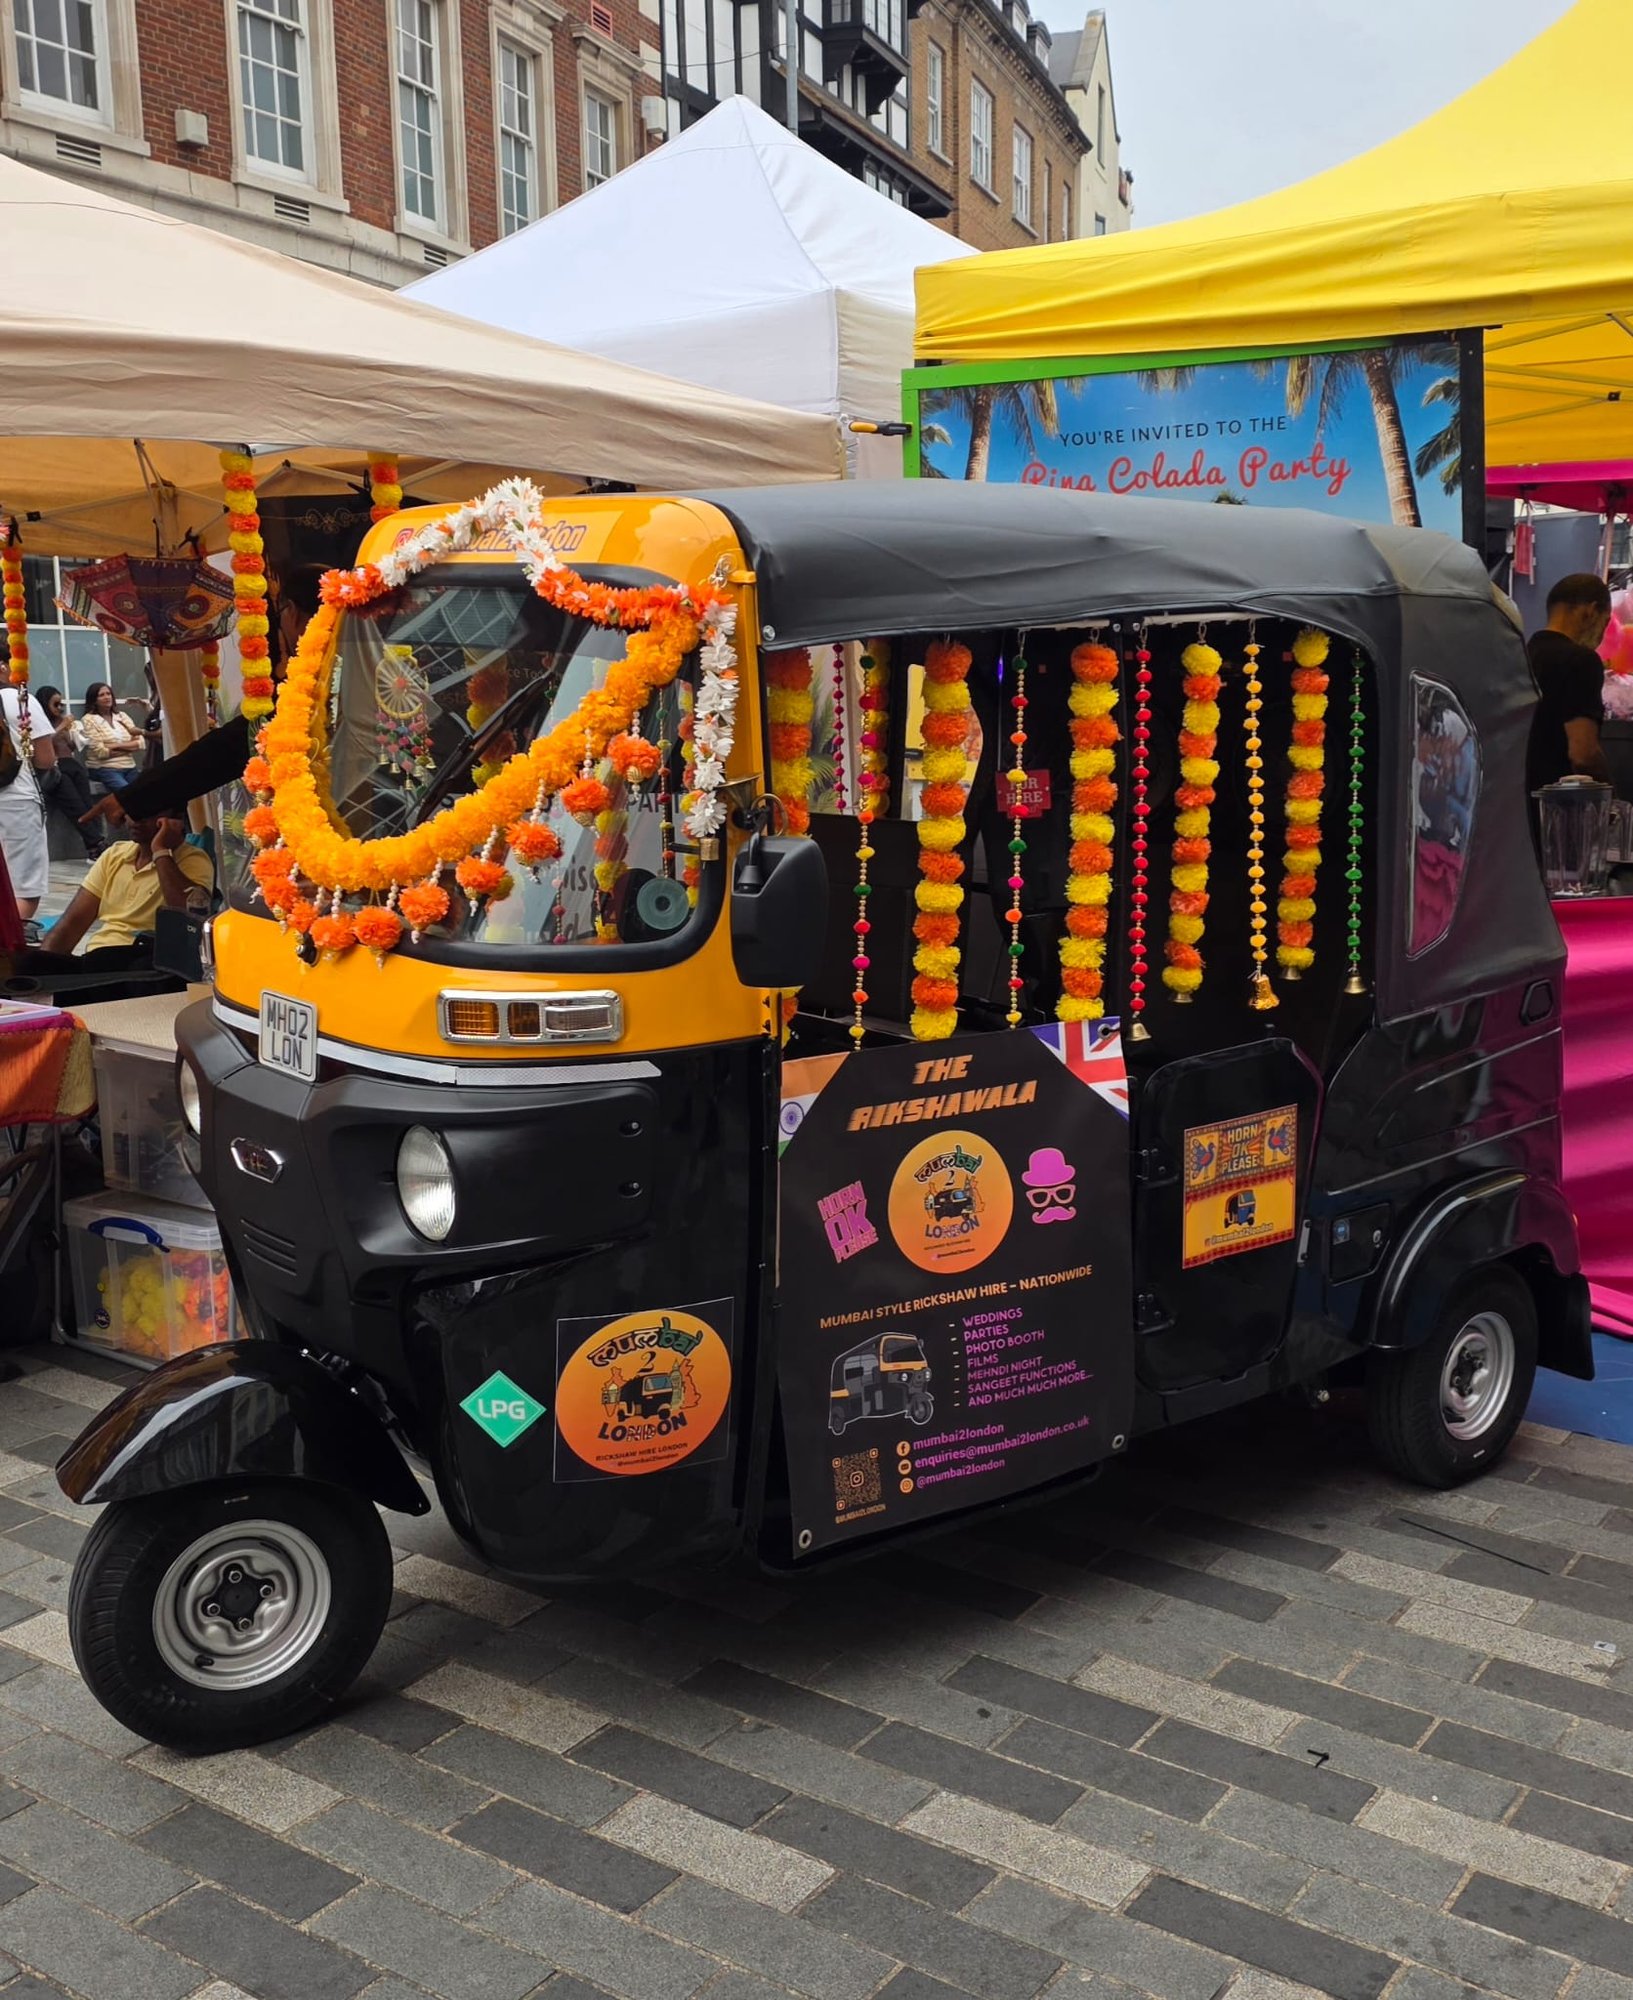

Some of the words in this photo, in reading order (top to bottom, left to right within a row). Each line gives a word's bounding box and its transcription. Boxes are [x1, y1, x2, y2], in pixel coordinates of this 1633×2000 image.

[1060, 430, 1125, 448] YOU'RE
[1132, 422, 1209, 442] INVITED
[1216, 420, 1242, 436] TO
[1249, 416, 1287, 433] THE
[1108, 448, 1226, 494] Colada
[1239, 442, 1351, 496] Party
[1006, 791, 1043, 804] HRE
[267, 998, 309, 1040] MH02
[271, 1031, 303, 1070] LON
[912, 1054, 973, 1084] THE
[847, 1080, 1038, 1131] RIKSHAWALA
[1227, 1124, 1258, 1142] HORN
[1221, 1155, 1258, 1173] PLEASE
[1231, 1142, 1249, 1158] OK
[944, 1169, 956, 1187] 2
[817, 1180, 865, 1221] HORN
[824, 1199, 872, 1249] OK
[820, 1309, 874, 1329] MUMBAI
[876, 1301, 911, 1318] STYLE
[913, 1286, 977, 1311] RICKSHAW
[979, 1282, 1008, 1298] HIRE
[1019, 1264, 1093, 1291] NATIONWIDE
[962, 1307, 1023, 1327] WEDDINGS
[964, 1324, 1009, 1341] PARTIES
[966, 1338, 1005, 1355] PHOTO
[1008, 1329, 1045, 1347] BOOTH
[636, 1350, 657, 1373] 2
[967, 1353, 999, 1368] FILMS
[967, 1364, 1009, 1381] MEHNDI
[1011, 1356, 1043, 1372] NIGHT
[968, 1375, 1018, 1394] SANGEET
[1019, 1360, 1077, 1383] FUNCTIONS
[968, 1394, 992, 1407] AND
[994, 1386, 1025, 1401] MUCH
[1027, 1378, 1056, 1394] MUCH
[478, 1398, 526, 1420] LPG
[598, 1411, 688, 1442] LONDON
[913, 1423, 1005, 1450] mumbai2london
[638, 1447, 655, 1456] HIRE
[658, 1442, 688, 1453] LONDON
[914, 1415, 1090, 1470] enquiries@mumbai2london.co.uk
[916, 1458, 1005, 1489] @mumbai2london
